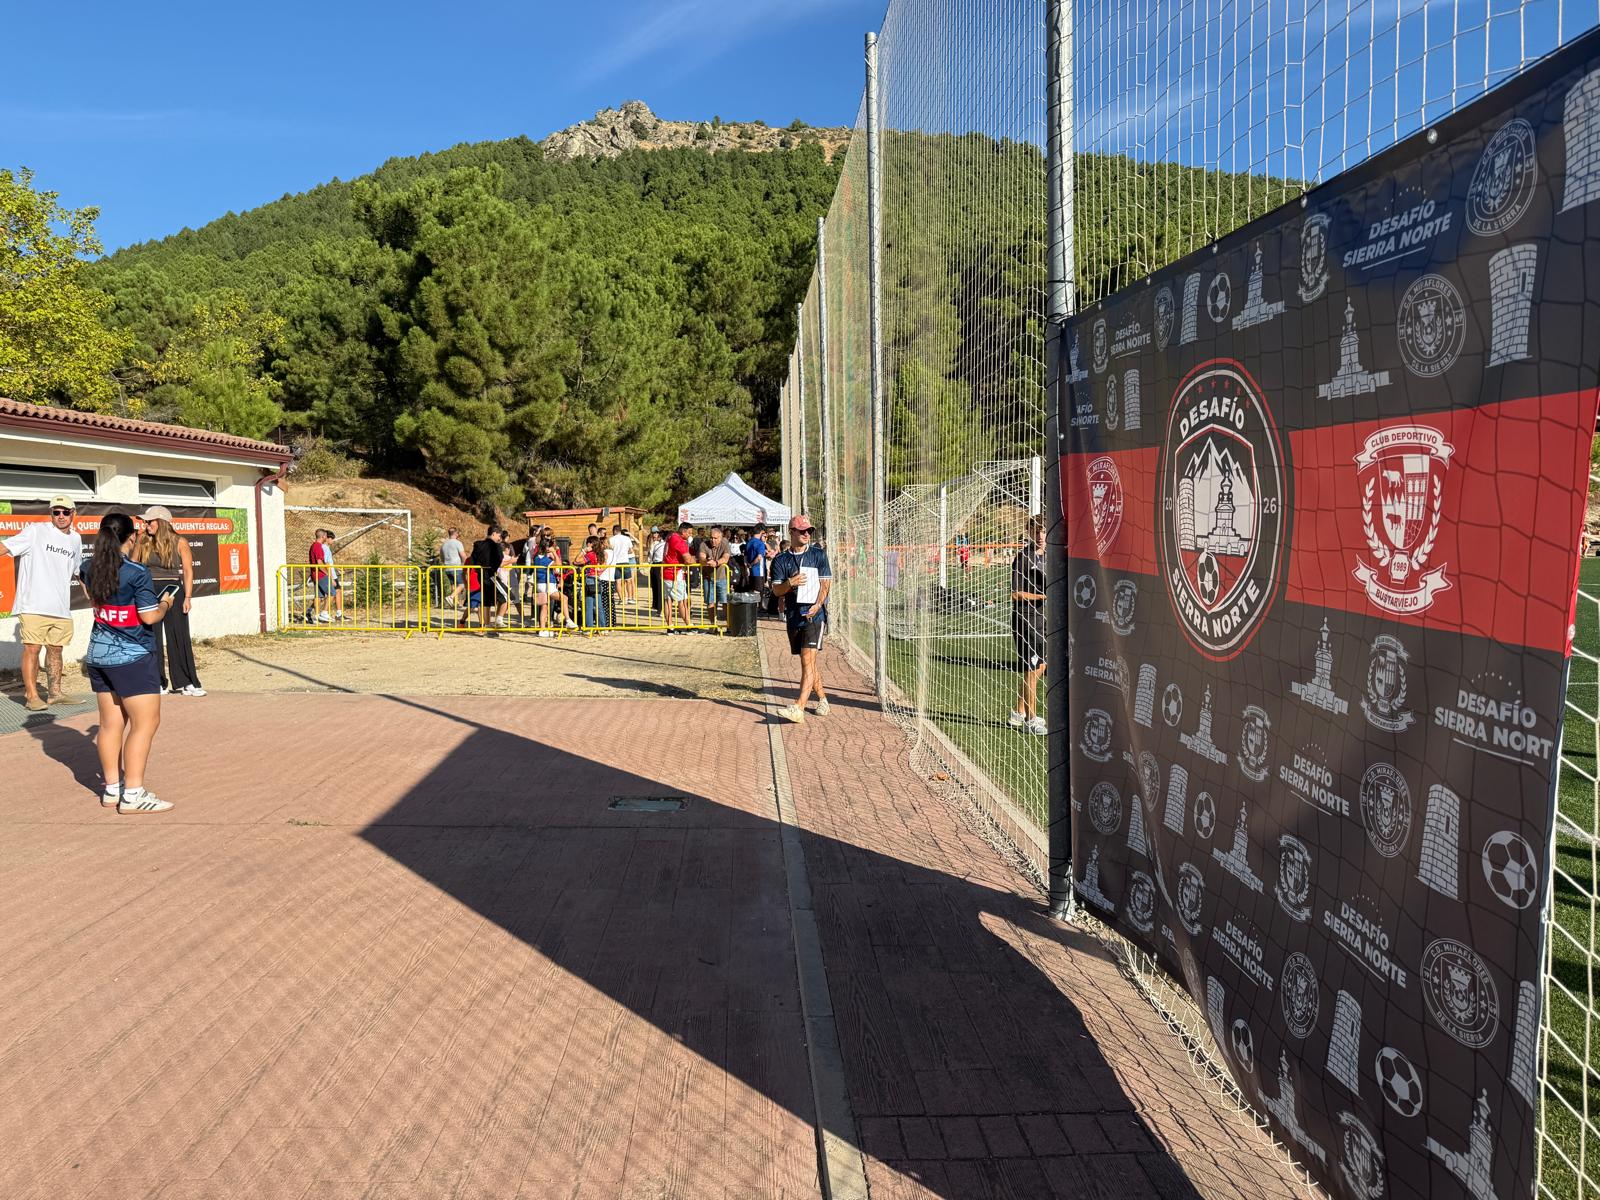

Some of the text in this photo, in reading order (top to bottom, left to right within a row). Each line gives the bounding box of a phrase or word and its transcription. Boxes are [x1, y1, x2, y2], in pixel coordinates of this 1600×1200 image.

[1368, 199, 1436, 241] DESAFÍO
[1494, 204, 1522, 229] SIERRA
[1343, 212, 1453, 268] SIERRA NORTE
[1413, 279, 1453, 297] MIRAFLORES
[1126, 332, 1151, 350] NORTE
[1180, 396, 1245, 439] DESAFÍO
[1371, 431, 1438, 448] CLUB DEPORTIVO
[1165, 497, 1173, 511] 20
[1263, 497, 1277, 513] 26
[45, 543, 72, 559] Hurley
[1172, 567, 1260, 638] SIERRA NORTE
[1375, 587, 1418, 608] BUSTARVIEJO
[1084, 665, 1114, 682] SIERRA
[1434, 706, 1488, 742] SIERRA
[1457, 689, 1537, 729] DESAFÍO
[1293, 753, 1333, 787] DESAFÍO
[1280, 765, 1309, 796] SIERRA
[1311, 783, 1350, 817] NORTE
[1226, 920, 1263, 962] DESAFÍO
[1341, 902, 1389, 951] DESAFÍO
[1212, 926, 1241, 963] SIERRA
[1243, 953, 1274, 992] NORTE
[1323, 910, 1362, 953] SIERRA
[1364, 941, 1407, 988] NORTE
[1443, 943, 1490, 984] MIRAFLORES
